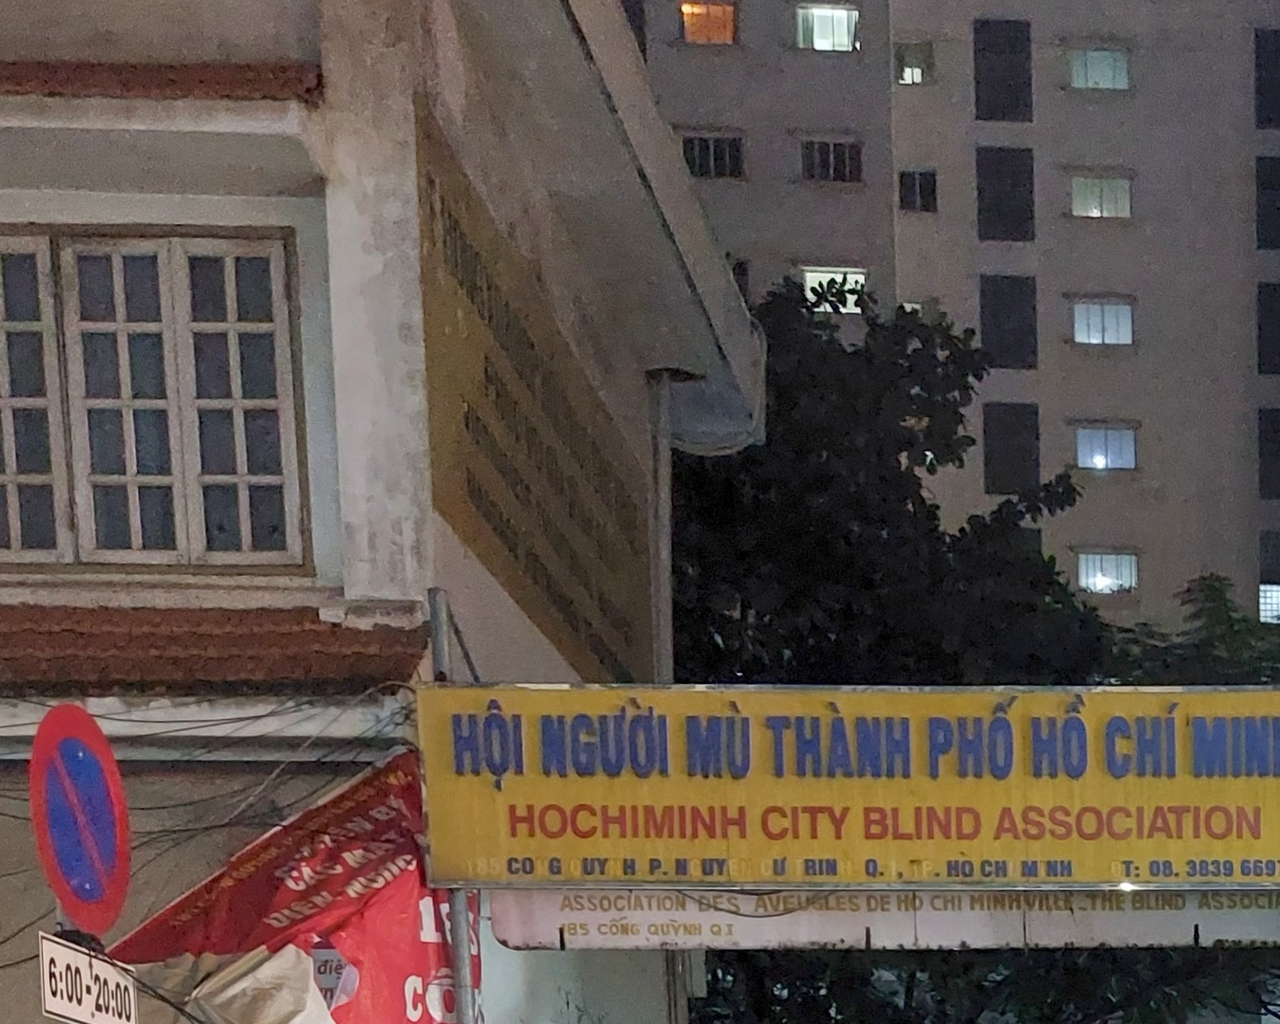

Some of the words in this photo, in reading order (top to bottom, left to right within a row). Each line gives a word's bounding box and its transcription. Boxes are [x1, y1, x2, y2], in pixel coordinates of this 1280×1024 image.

[452, 698, 524, 792] HỘI
[541, 697, 670, 778] NGƯỜI
[686, 700, 751, 779] MÙ
[765, 701, 911, 779] THÀNH
[928, 696, 1019, 780] PHỐ
[1031, 694, 1088, 780] HỒ
[1106, 702, 1180, 779] CHÍ
[508, 803, 748, 840] HOCHIMINH
[760, 805, 849, 841] CITY
[864, 806, 981, 841] BLIND
[994, 805, 1262, 841] ASSOCIATION
[1186, 859, 1234, 878] 3839
[560, 894, 687, 912] ASSOCIATION
[754, 893, 862, 912] AVEUGLES
[866, 894, 891, 912] DE
[931, 893, 962, 911] CHI
[1132, 893, 1186, 911] BLIND
[48, 956, 132, 1023] 6:00-20:00
